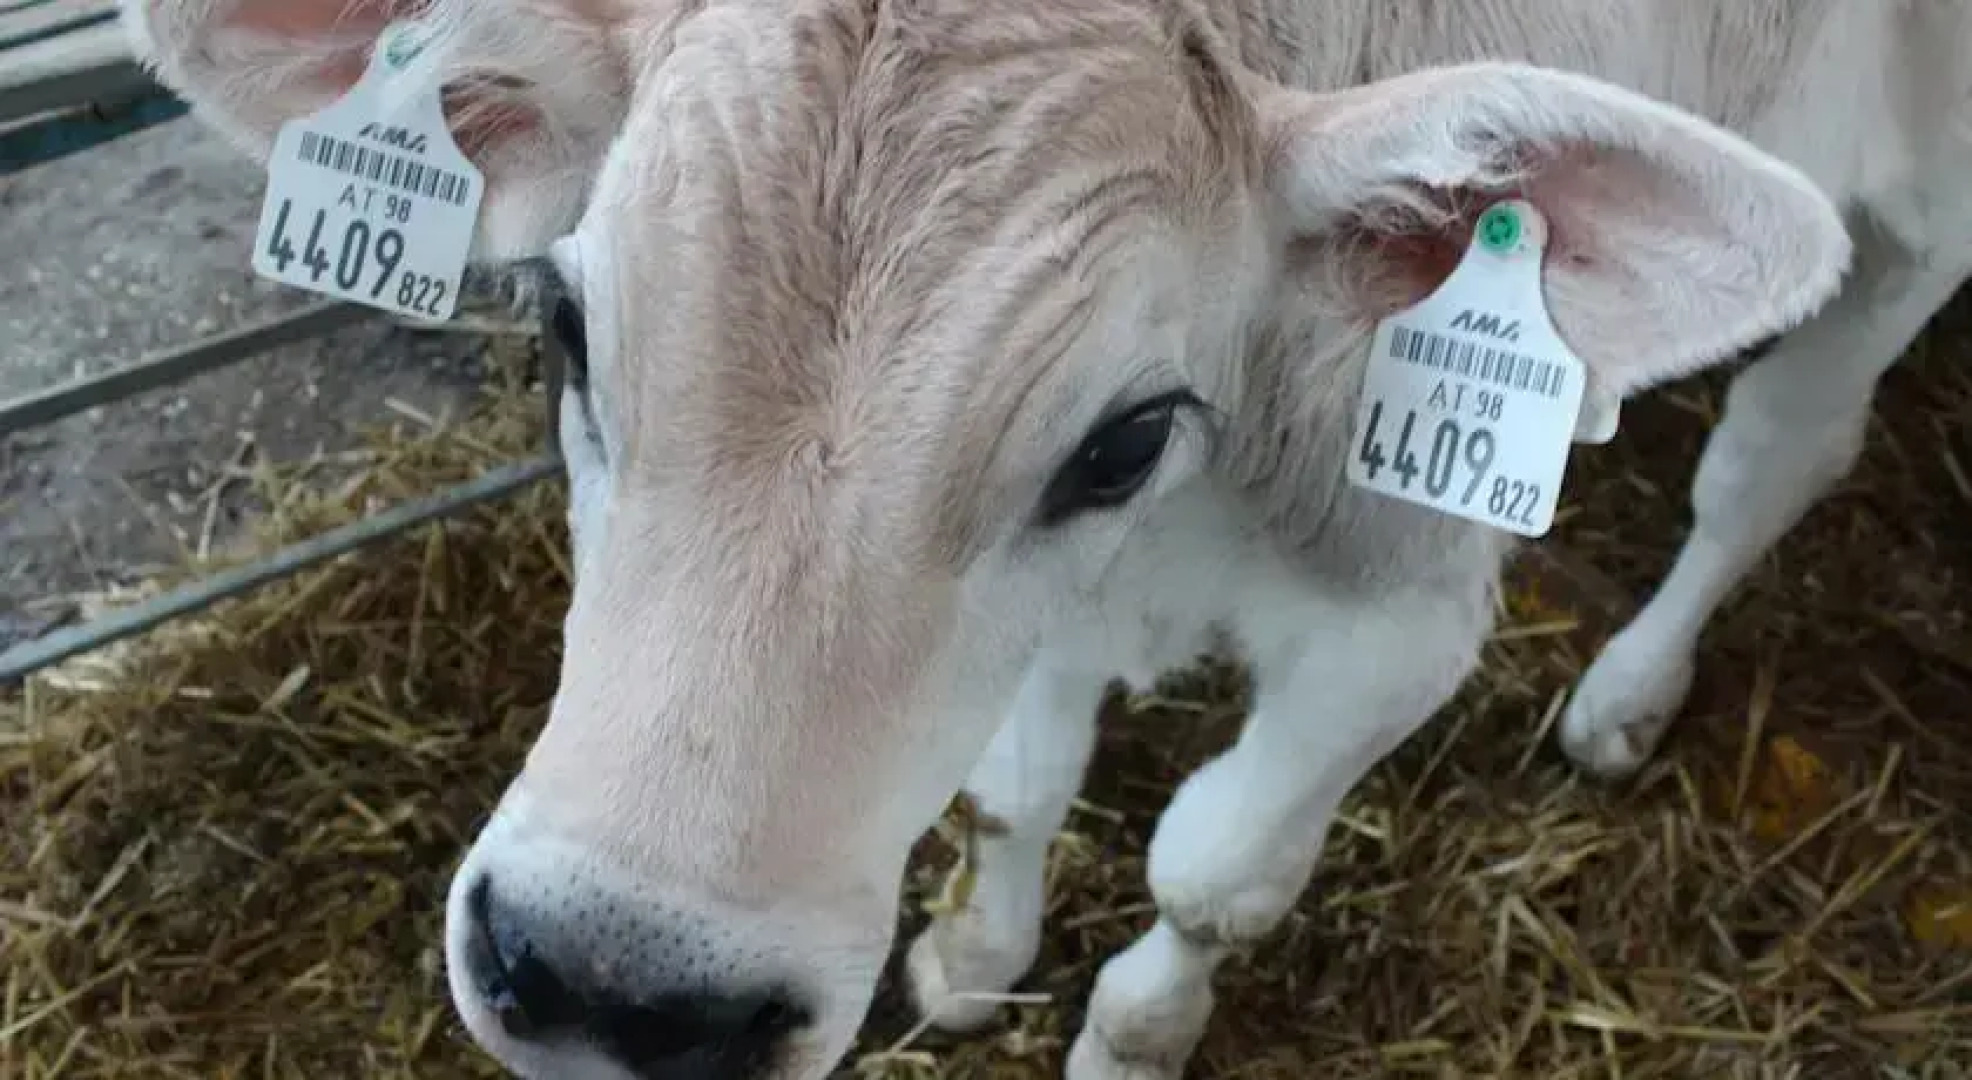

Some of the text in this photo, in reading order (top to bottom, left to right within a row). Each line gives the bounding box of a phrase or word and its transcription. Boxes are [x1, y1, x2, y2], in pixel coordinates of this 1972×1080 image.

[338, 183, 413, 223] AT 98
[267, 198, 447, 317] 4409 822
[1427, 378, 1503, 421] AT 98
[1359, 400, 1541, 527] 4409 822
